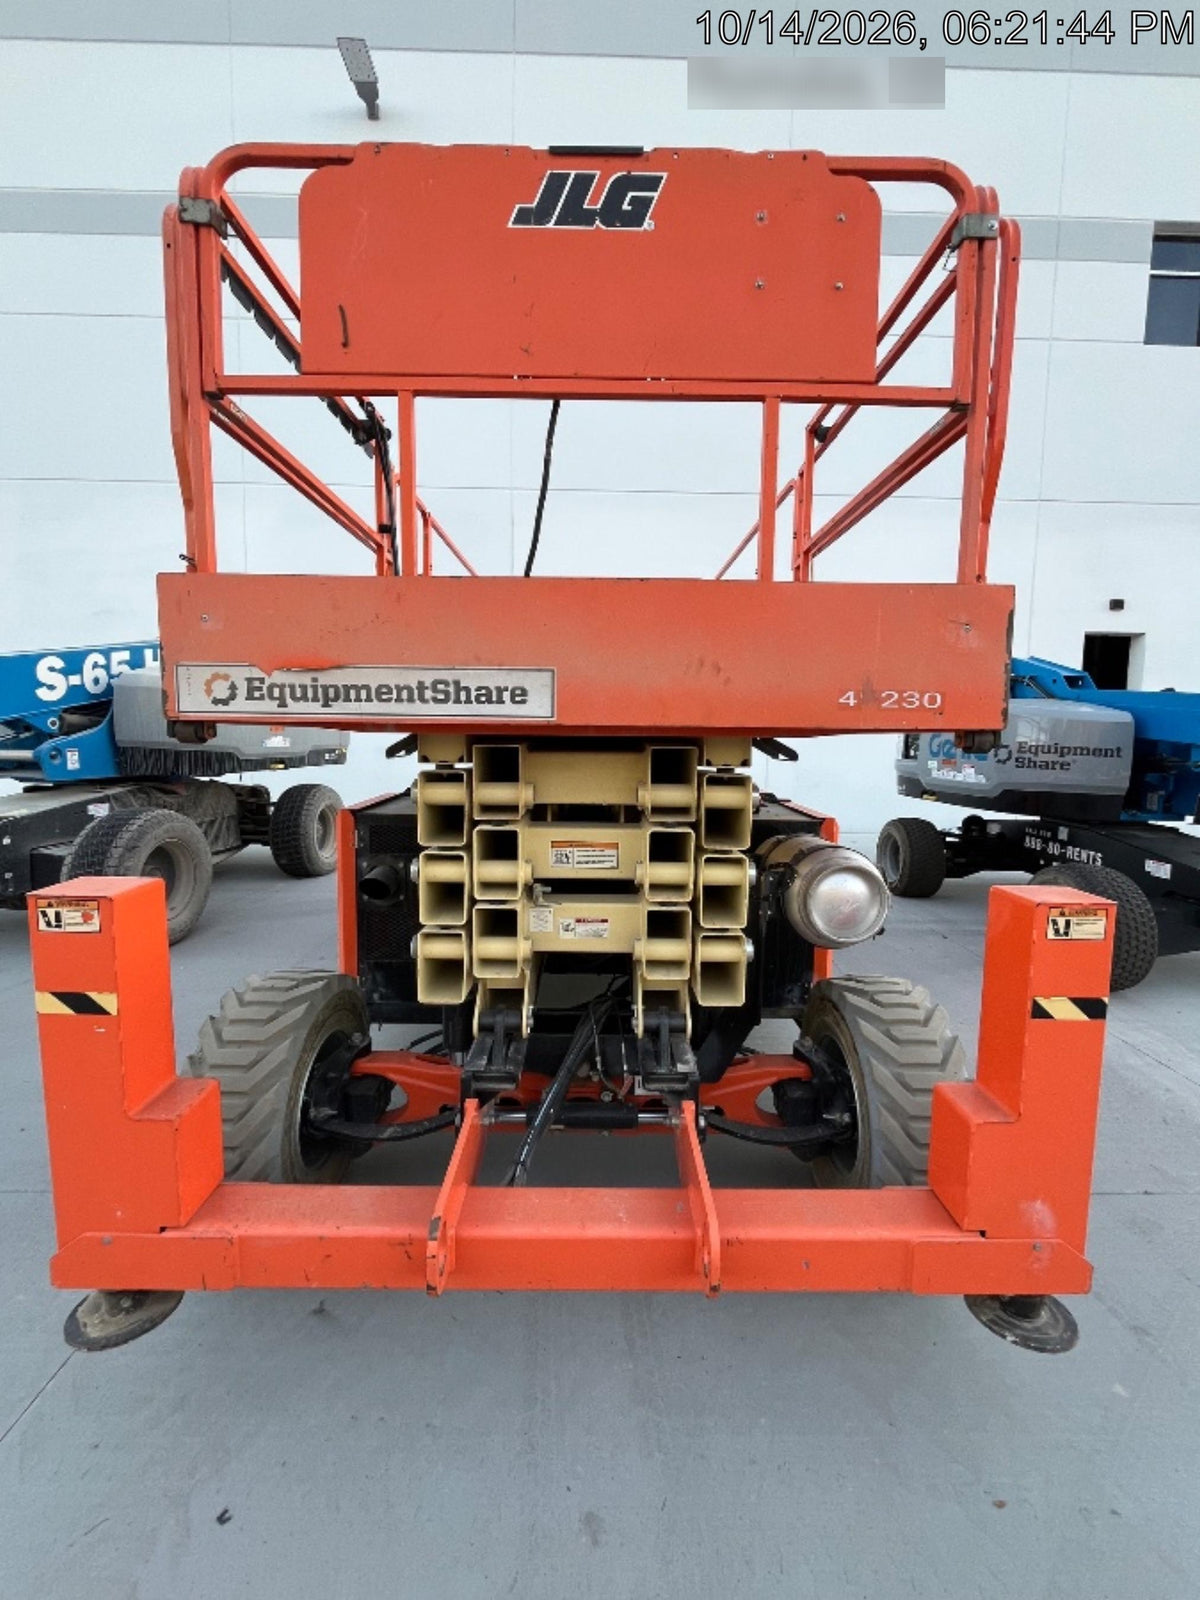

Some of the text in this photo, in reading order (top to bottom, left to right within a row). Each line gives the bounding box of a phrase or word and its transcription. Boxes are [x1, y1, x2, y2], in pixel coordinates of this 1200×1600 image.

[507, 170, 668, 231] JLG
[244, 676, 529, 708] EquipmentShare
[1016, 741, 1123, 759] Equipment
[1015, 757, 1071, 771] Share
